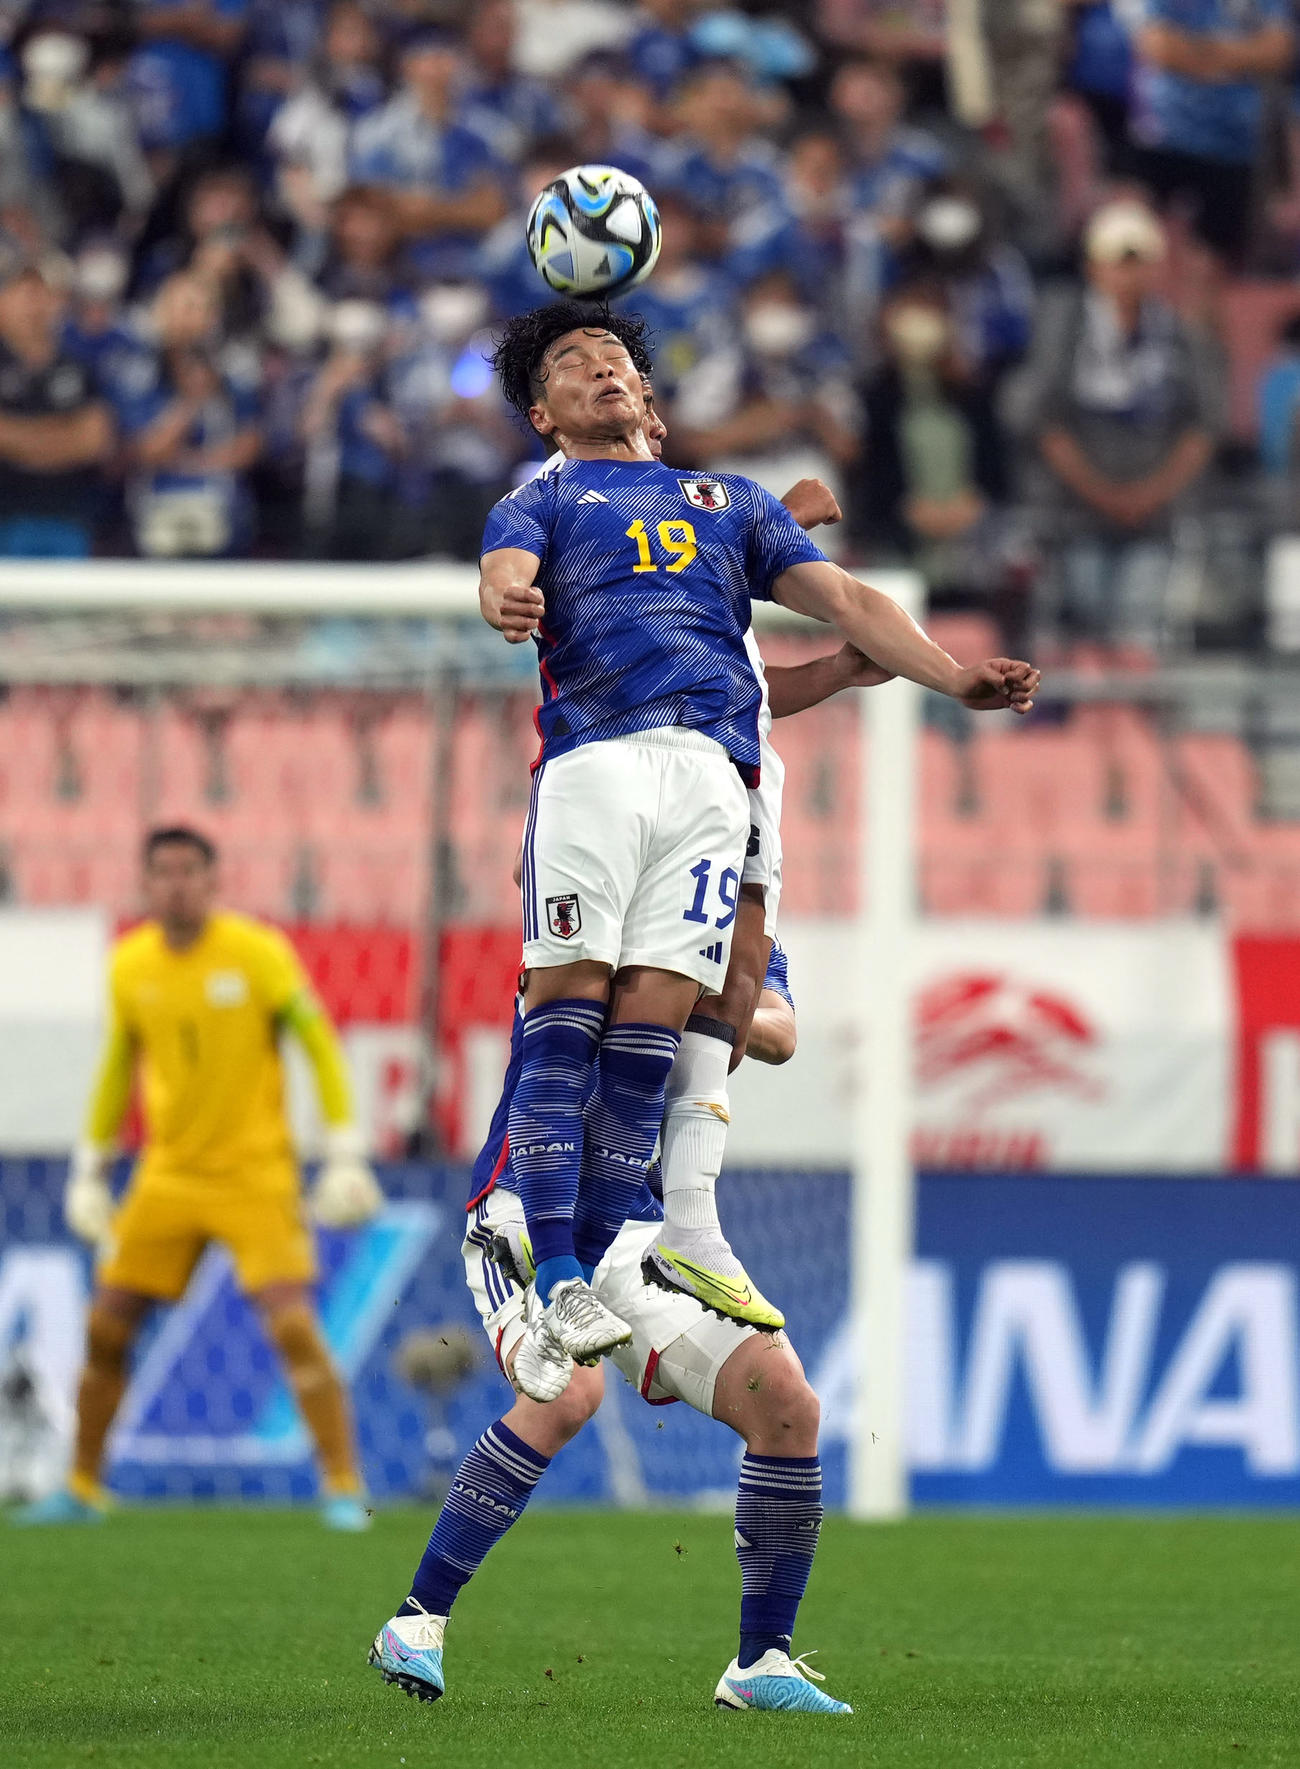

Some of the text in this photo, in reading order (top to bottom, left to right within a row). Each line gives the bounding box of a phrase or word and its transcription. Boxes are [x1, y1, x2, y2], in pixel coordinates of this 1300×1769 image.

[625, 519, 697, 573] 19
[553, 895, 571, 903] JAPAN
[683, 858, 739, 930] 19
[509, 1142, 575, 1159] JAPAN
[596, 1148, 652, 1169] JAPA
[453, 1483, 518, 1518] JAPAN
